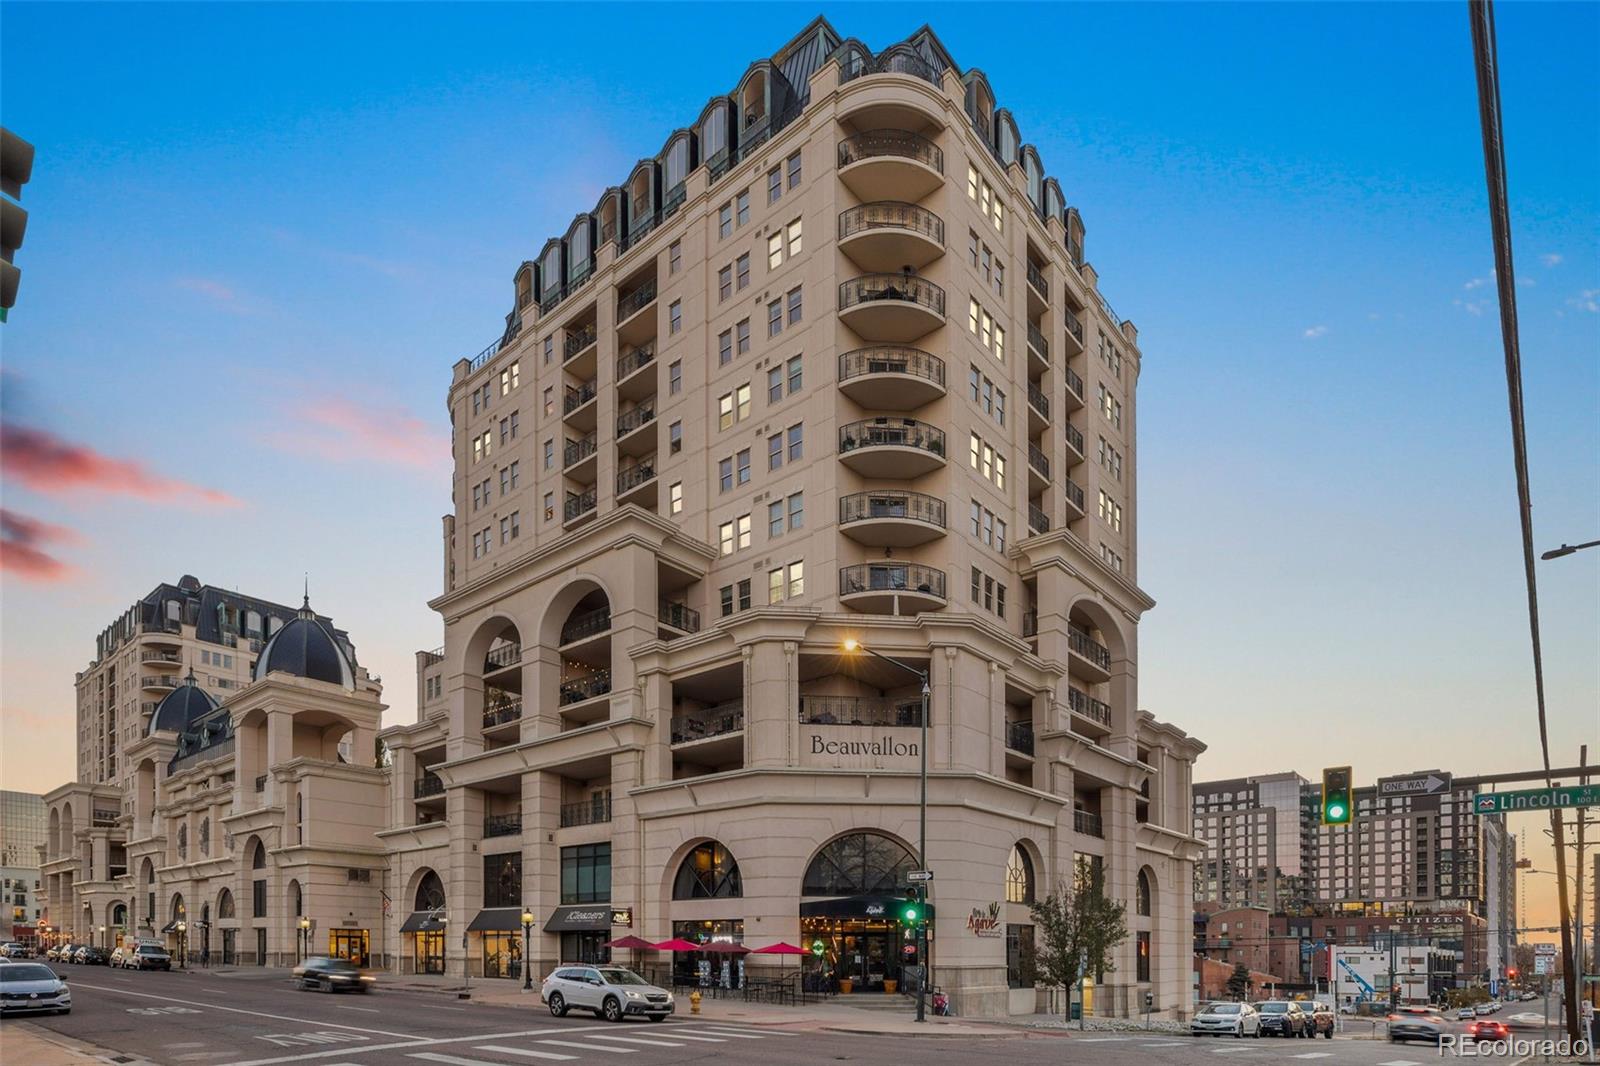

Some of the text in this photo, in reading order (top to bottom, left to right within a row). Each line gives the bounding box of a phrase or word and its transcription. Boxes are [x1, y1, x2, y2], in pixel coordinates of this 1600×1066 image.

[810, 735, 919, 756] Beauvallon
[1384, 780, 1427, 791] ONE WAY
[1501, 791, 1570, 809] Lincoln
[967, 914, 1000, 935] Agave
[1395, 916, 1464, 924] CITIZEN
